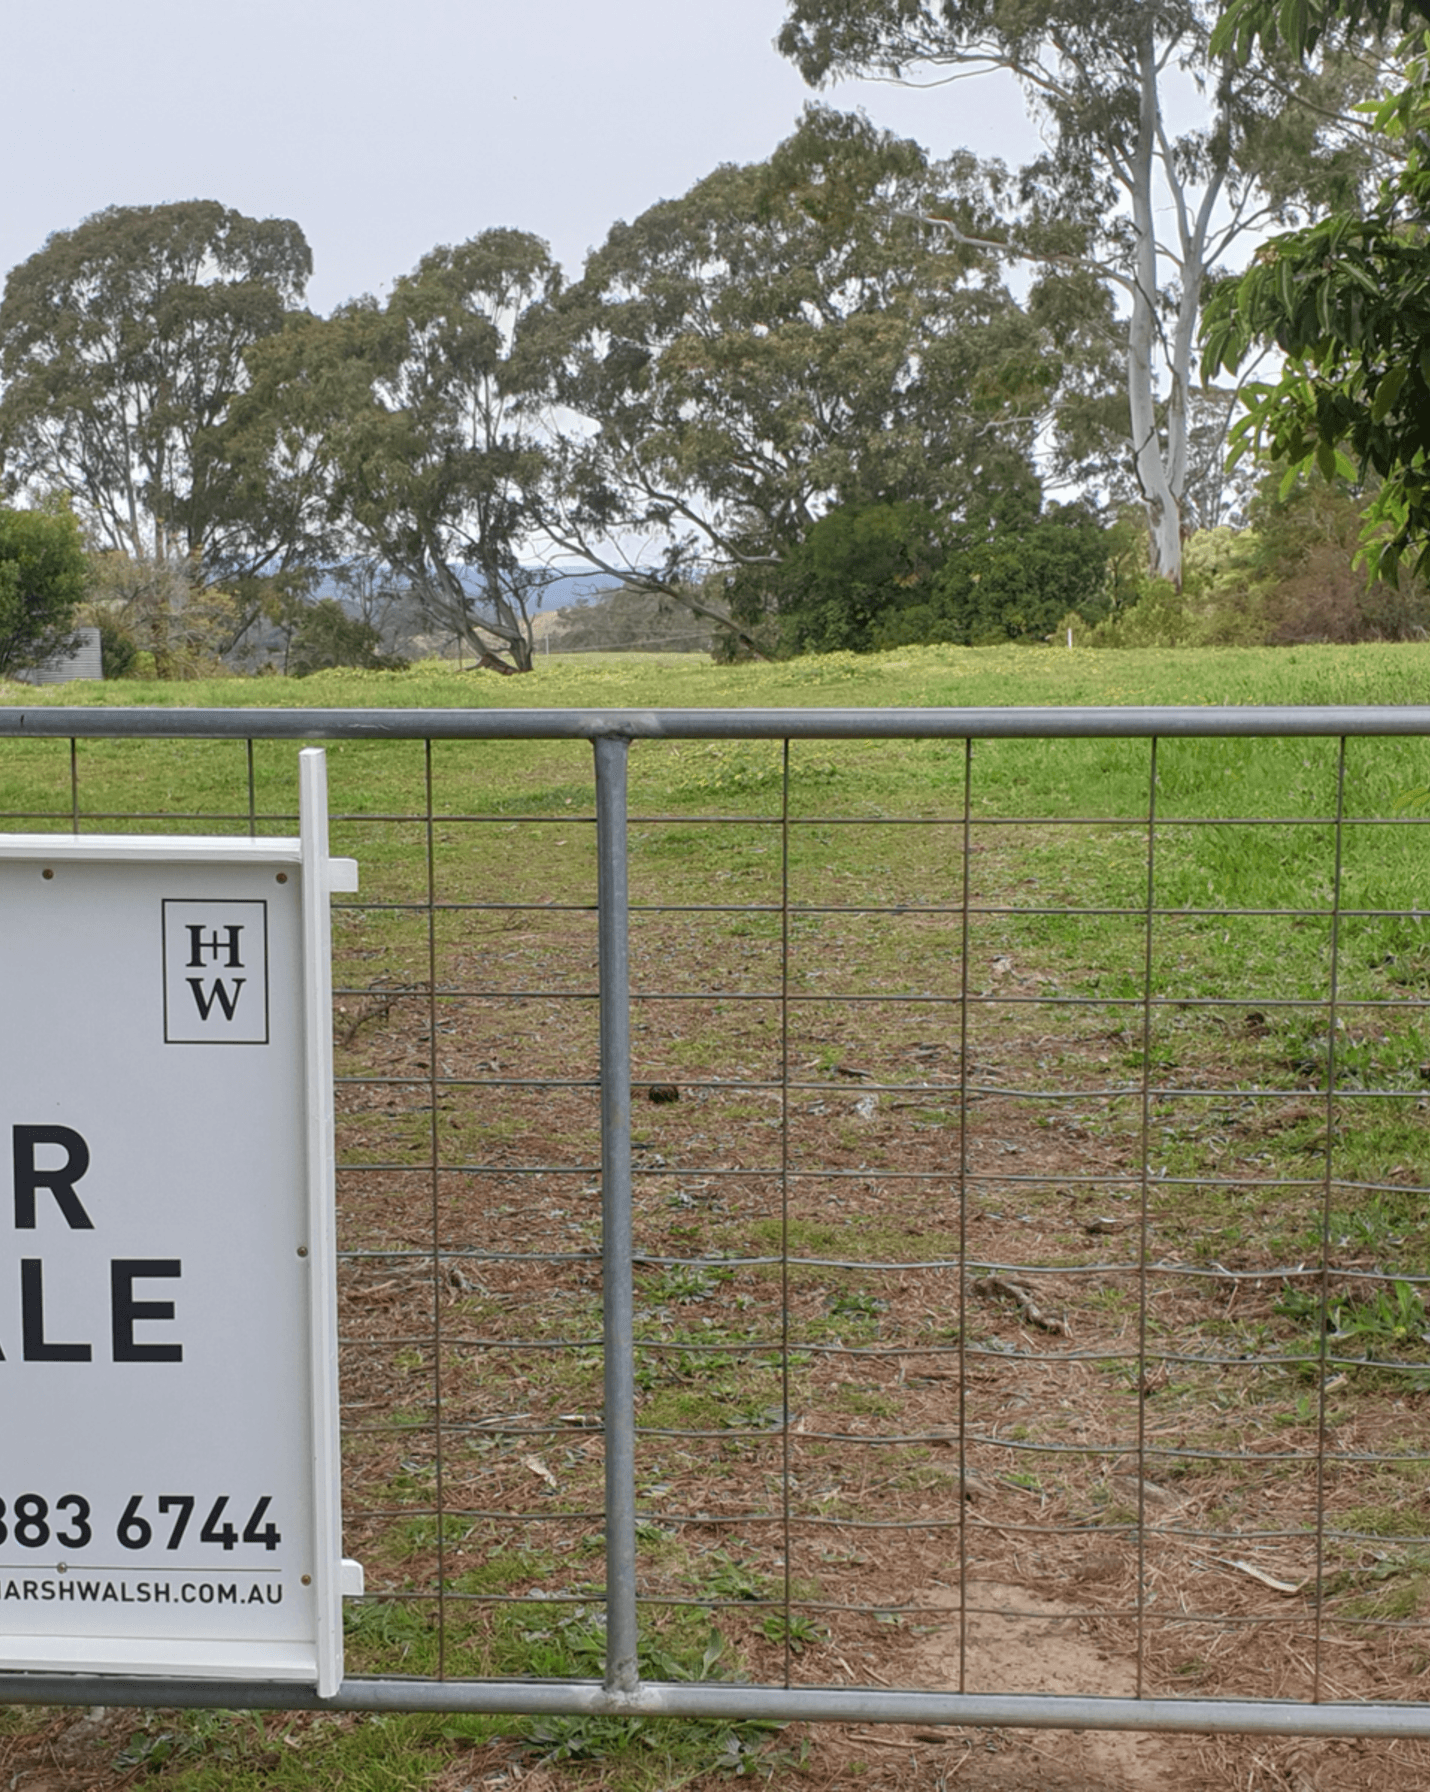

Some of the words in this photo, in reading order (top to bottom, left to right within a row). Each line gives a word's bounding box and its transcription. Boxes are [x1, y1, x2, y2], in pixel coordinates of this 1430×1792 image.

[185, 977, 247, 1021] W
[0, 1258, 183, 1362] LE
[0, 1492, 92, 1549] 83
[116, 1494, 281, 1551] 6744
[0, 1579, 283, 1605] ARSHWALSH.COM.AU
